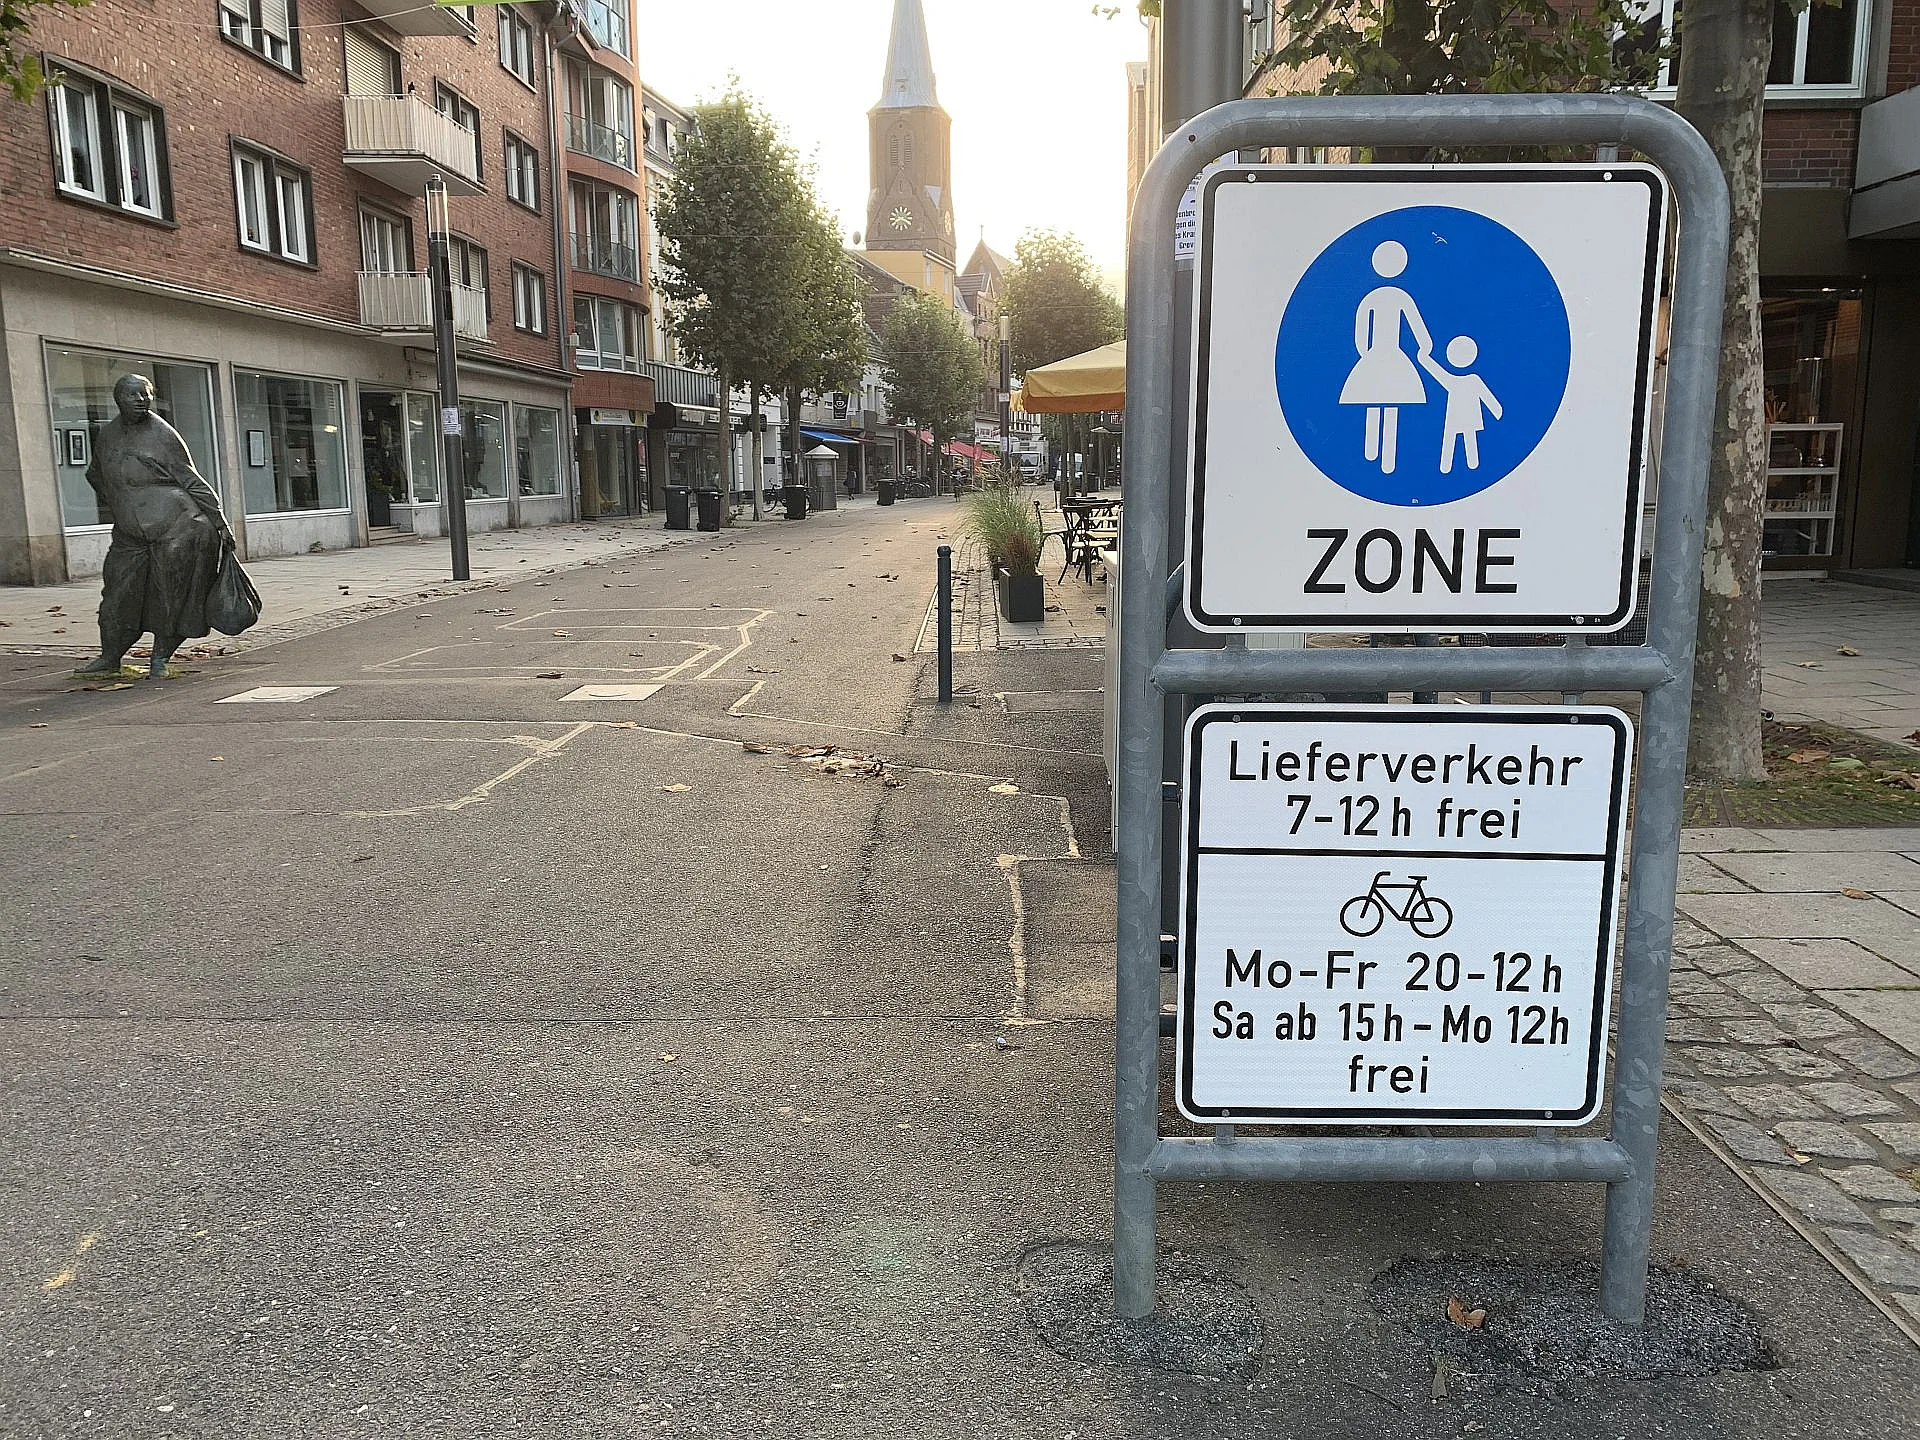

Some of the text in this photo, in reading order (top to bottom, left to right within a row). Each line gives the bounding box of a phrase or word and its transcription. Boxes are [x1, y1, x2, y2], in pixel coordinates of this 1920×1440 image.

[1304, 528, 1521, 594] ZONE
[1229, 740, 1583, 786] Lieferverkehr
[1436, 797, 1521, 839] frei
[1226, 948, 1379, 990] Mo-Fr
[1212, 1001, 1254, 1040] Sa
[1275, 1002, 1317, 1041] ab
[1508, 1005, 1569, 1045] 12h
[1349, 1055, 1429, 1094] frei
